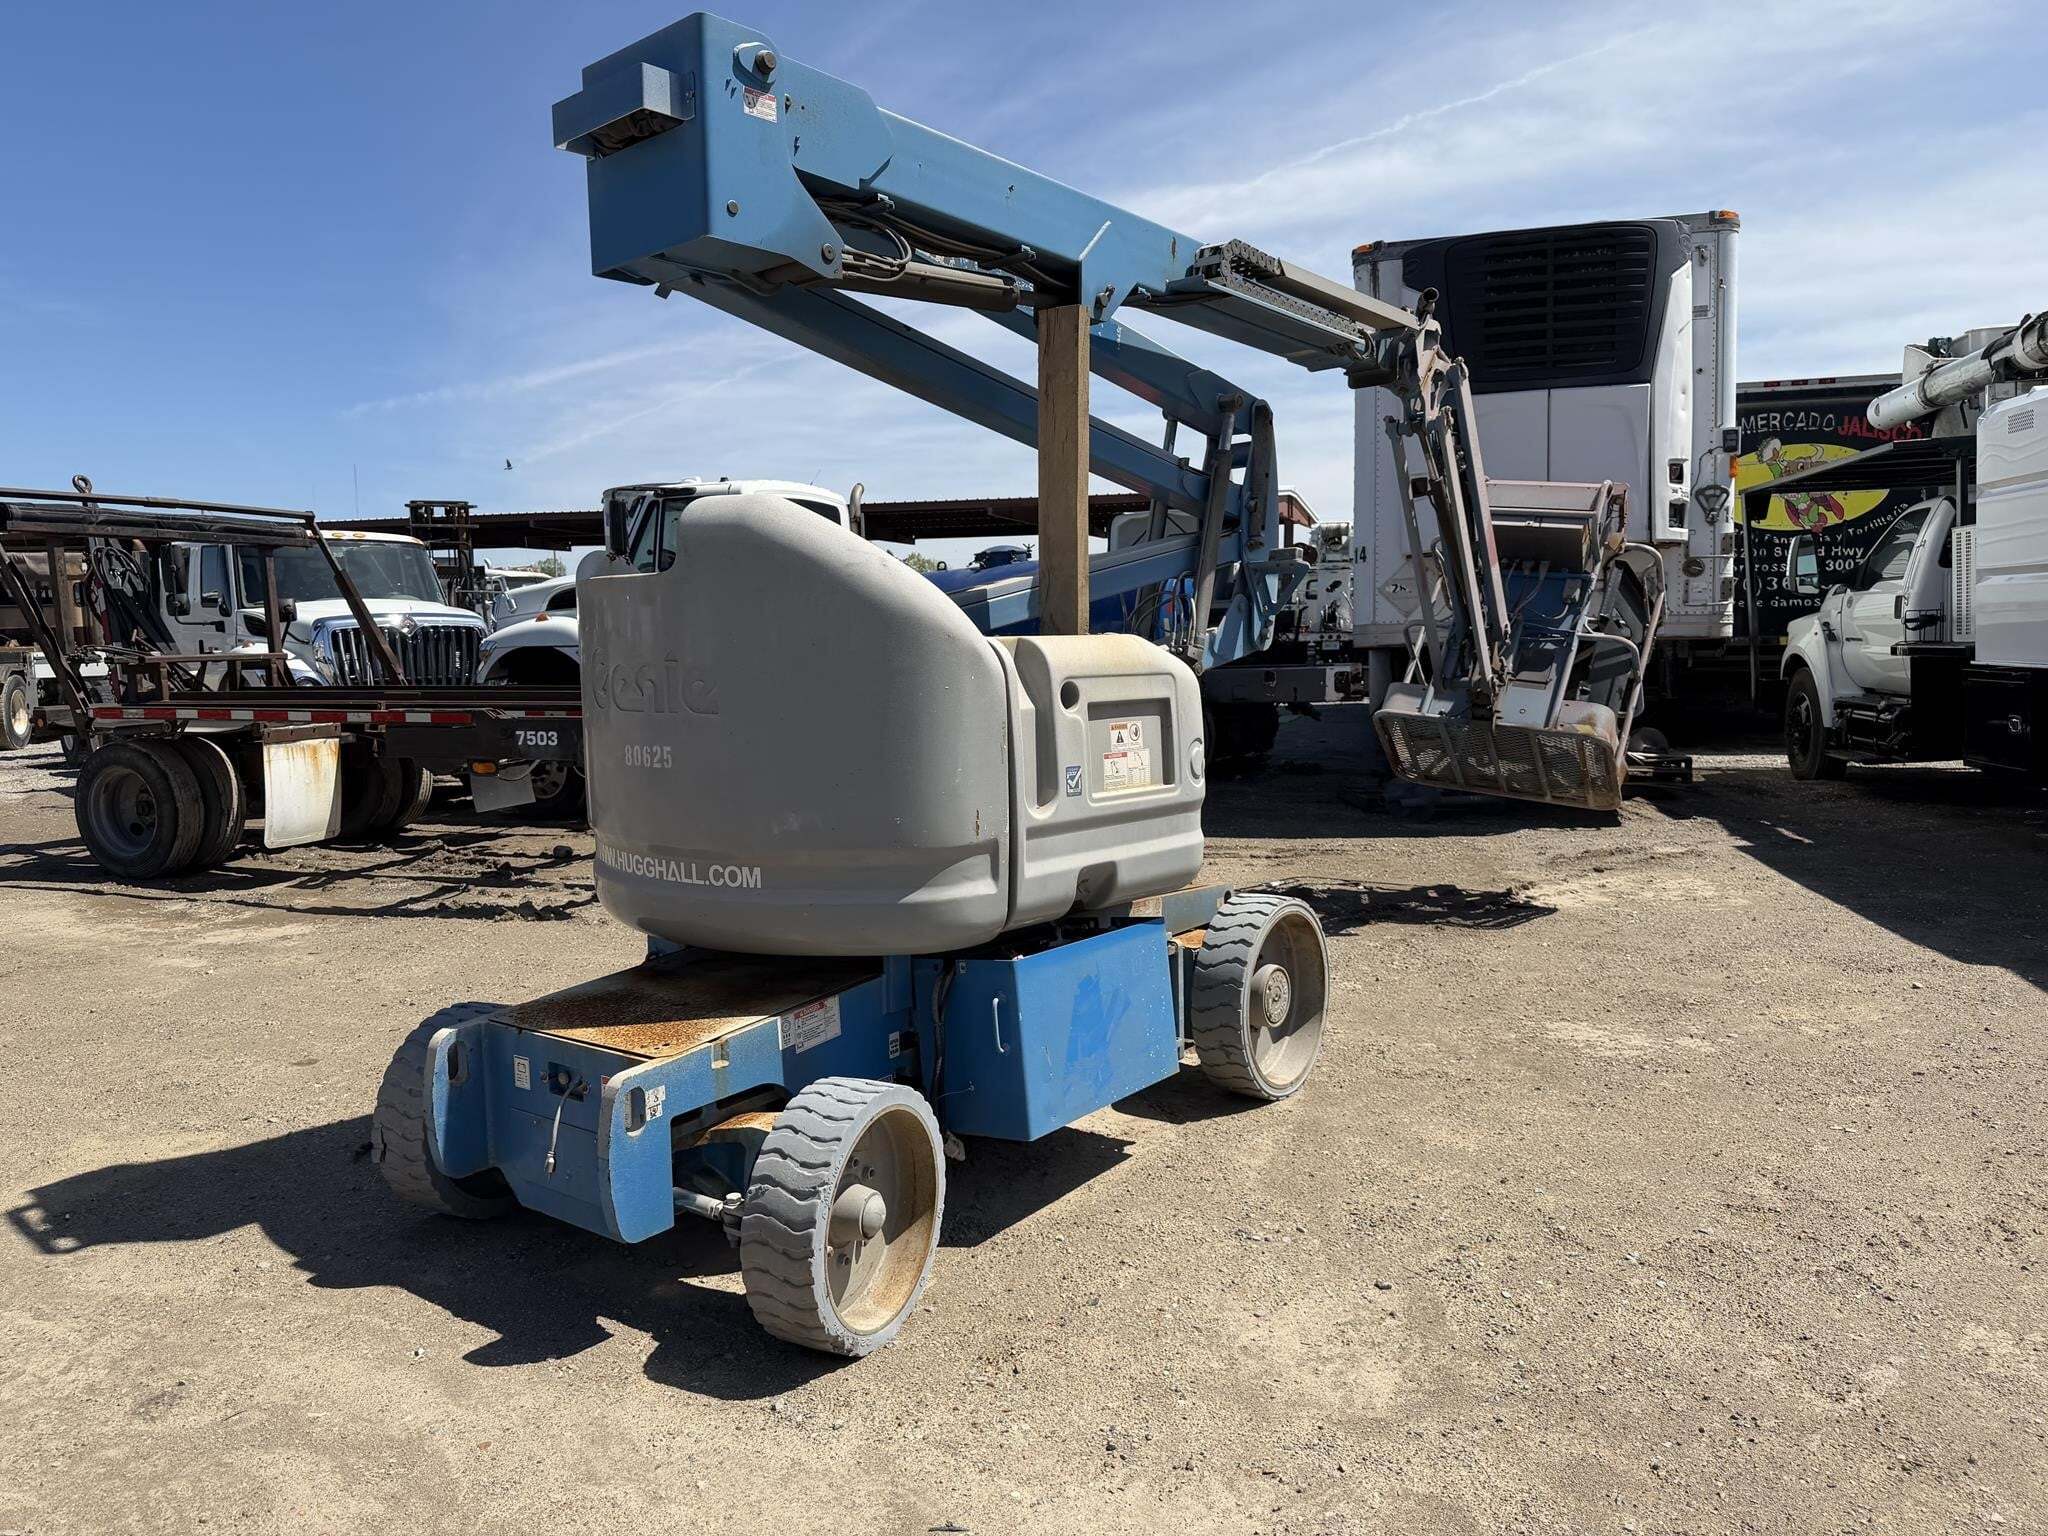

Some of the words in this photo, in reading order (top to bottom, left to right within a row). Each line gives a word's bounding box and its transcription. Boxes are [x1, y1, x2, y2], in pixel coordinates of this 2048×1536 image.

[1741, 411, 1835, 434] MERCADO
[1831, 546, 1864, 558] Hwy
[515, 730, 558, 746] 7503
[624, 744, 673, 768] 80625
